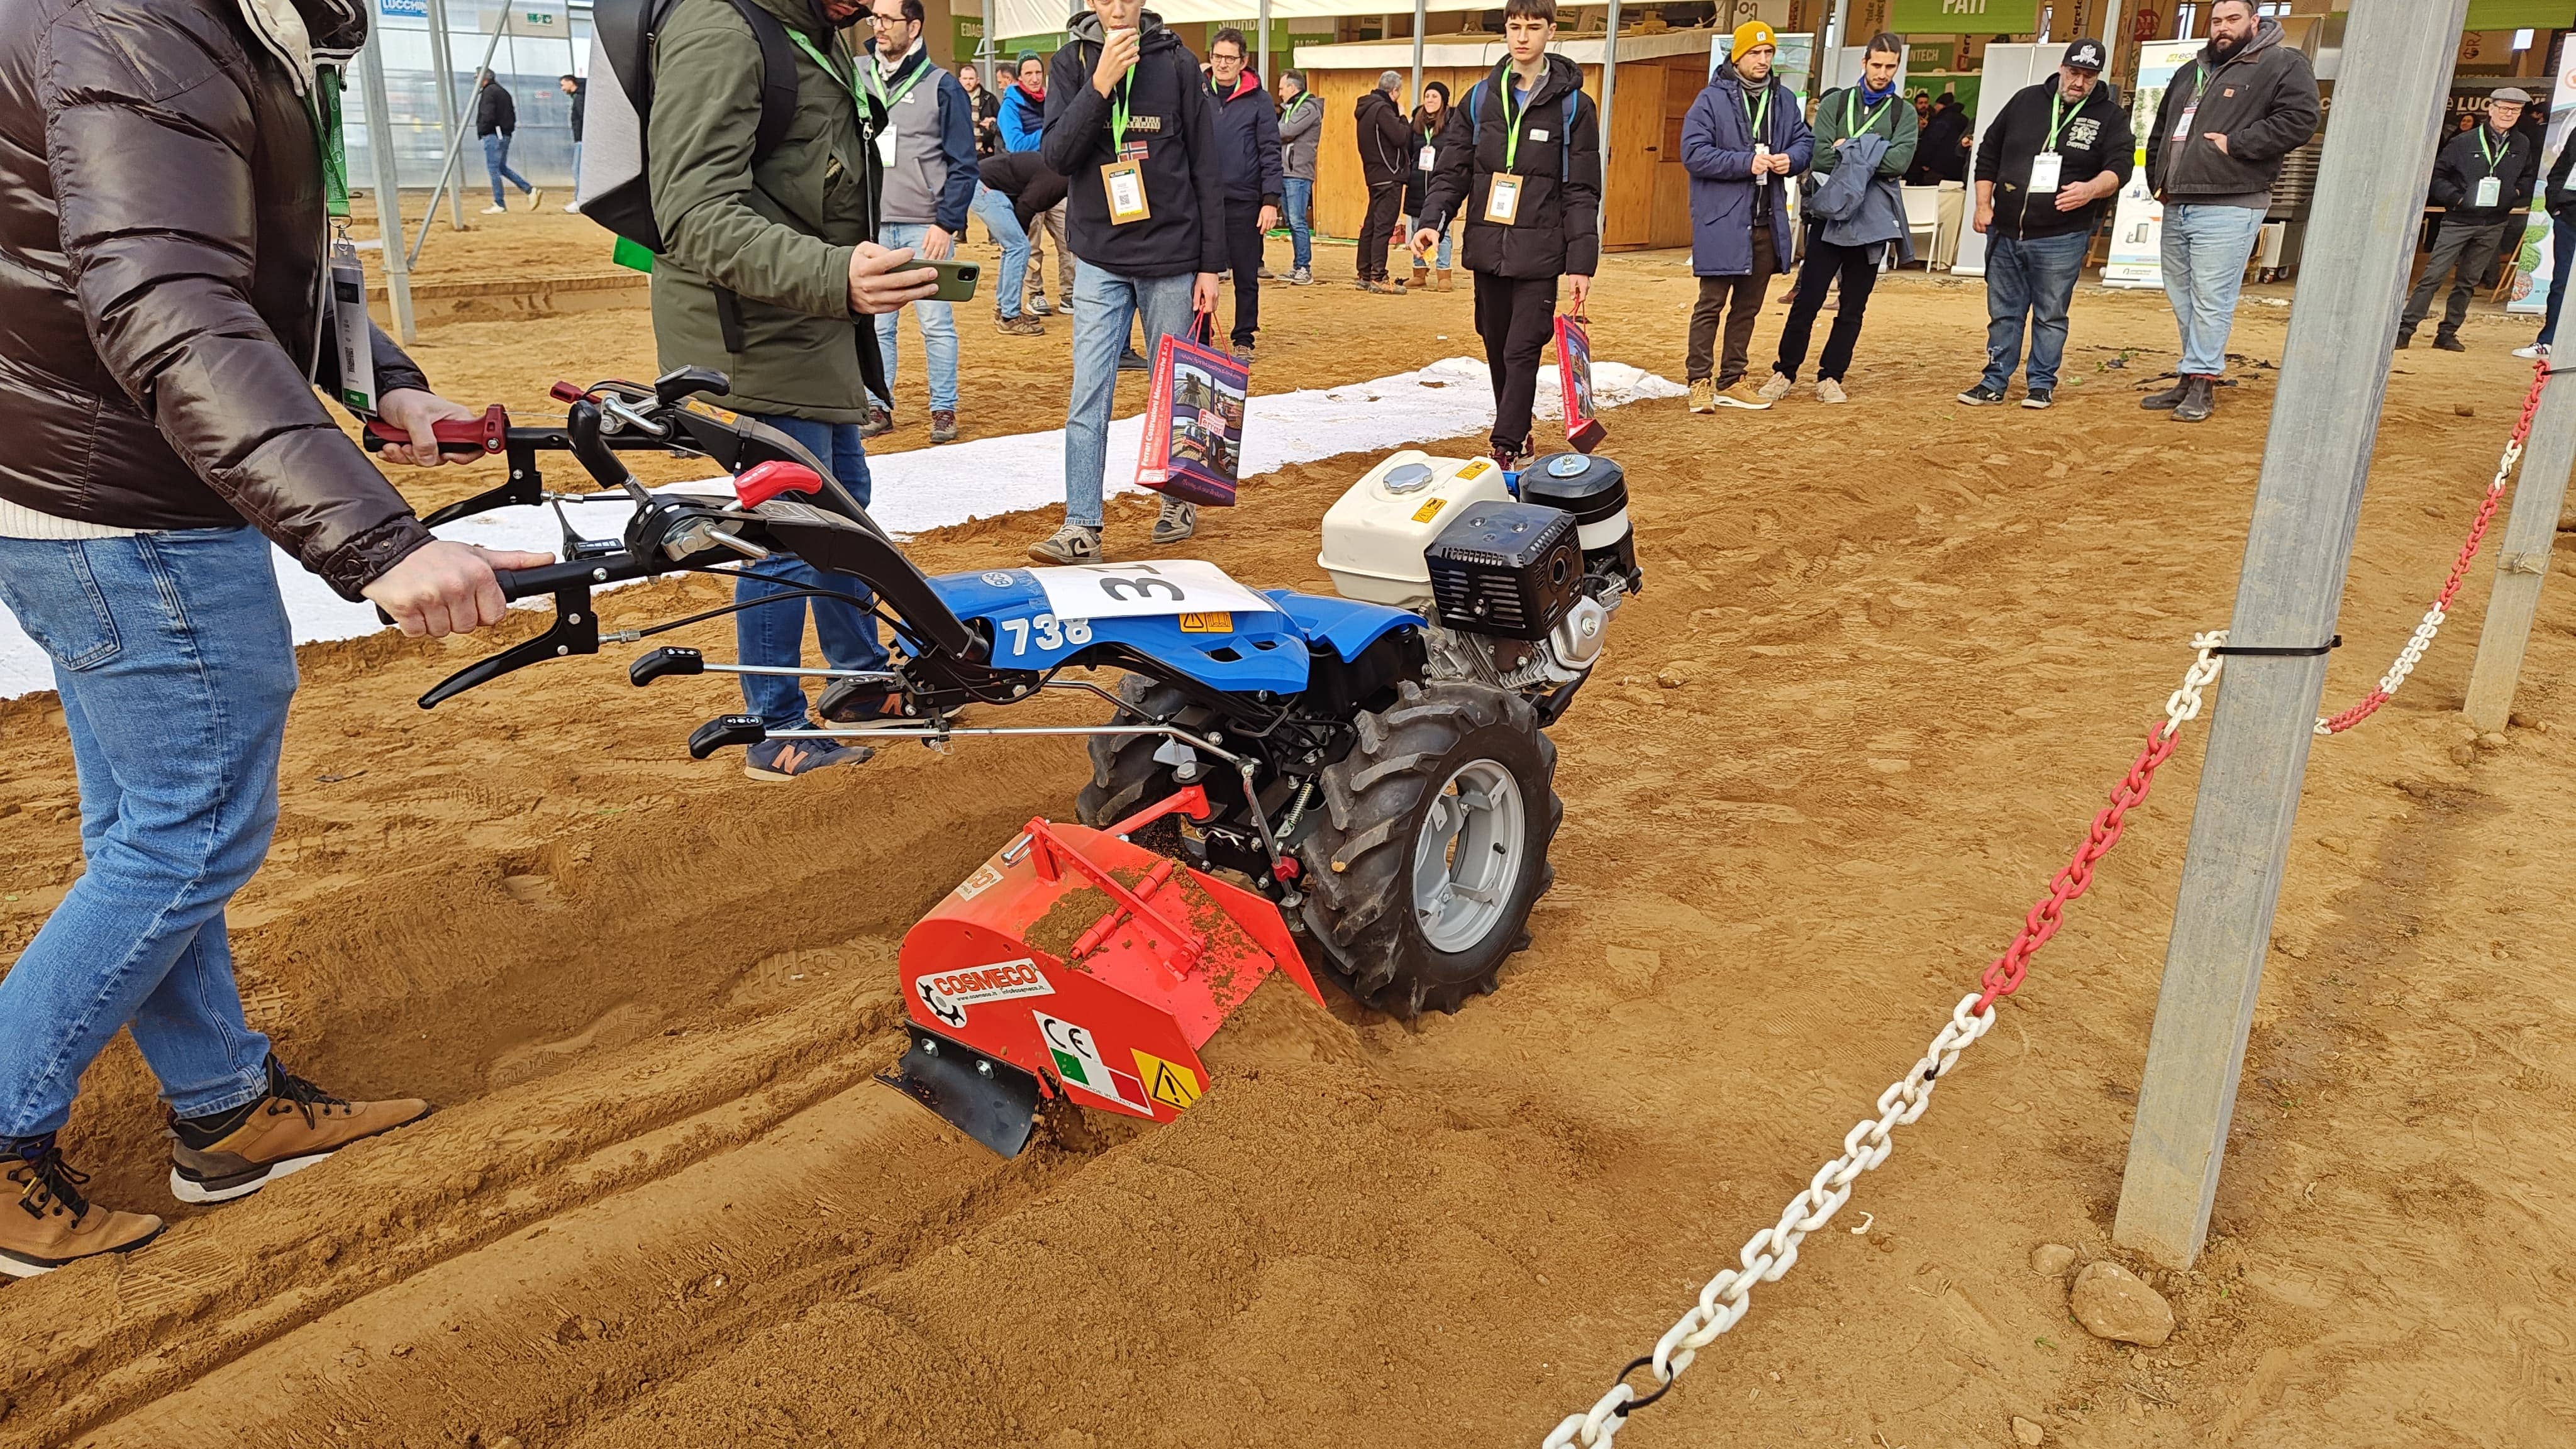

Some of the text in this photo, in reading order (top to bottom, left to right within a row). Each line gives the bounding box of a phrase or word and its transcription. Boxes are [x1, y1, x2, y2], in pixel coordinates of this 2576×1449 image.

[1910, 49, 1940, 62] NTECH
[1001, 614, 1092, 656] 738
[933, 964, 1038, 996] COSMECO
[1044, 1019, 1092, 1059] CE
